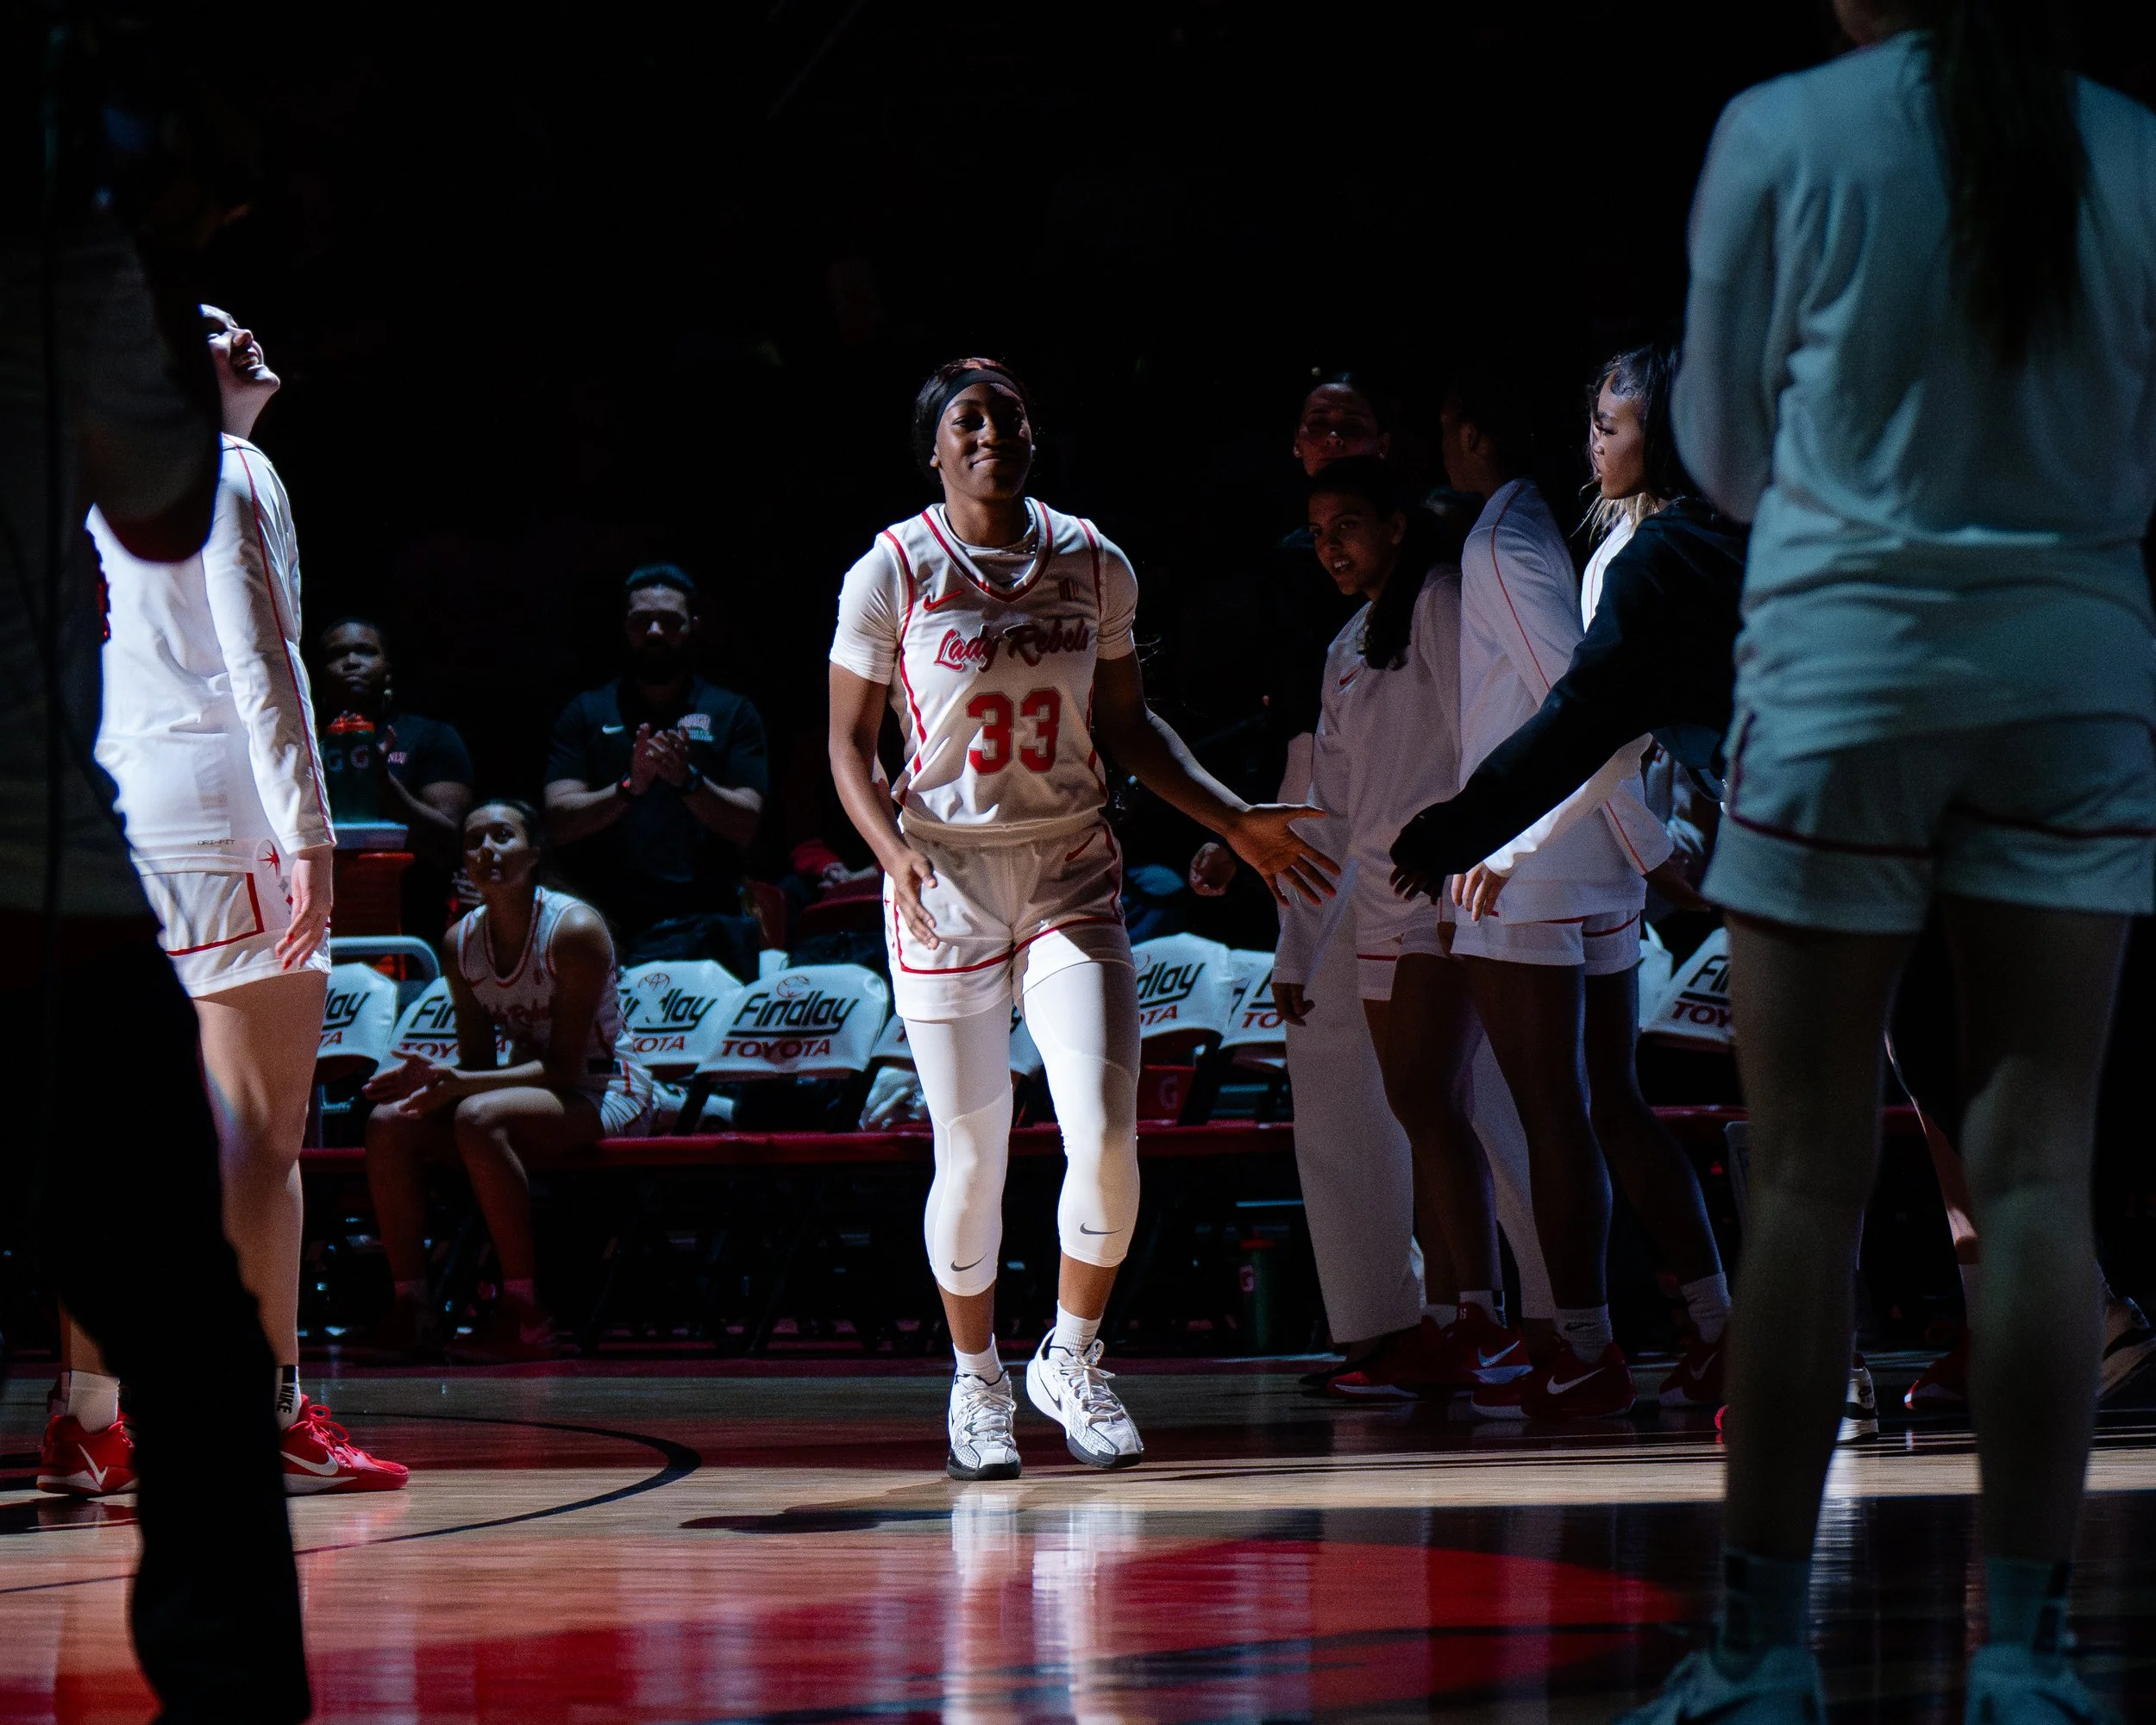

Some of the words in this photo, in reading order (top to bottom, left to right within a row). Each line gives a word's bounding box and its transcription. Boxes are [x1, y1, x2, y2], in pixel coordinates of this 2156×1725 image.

[934, 623, 1002, 673] Lady
[1003, 617, 1090, 668] Rebels
[966, 687, 1061, 775] 33
[350, 744, 371, 770] G
[733, 990, 859, 1032] Findlay
[721, 1038, 830, 1059] TOYOTA
[277, 1383, 295, 1414] NIKE
